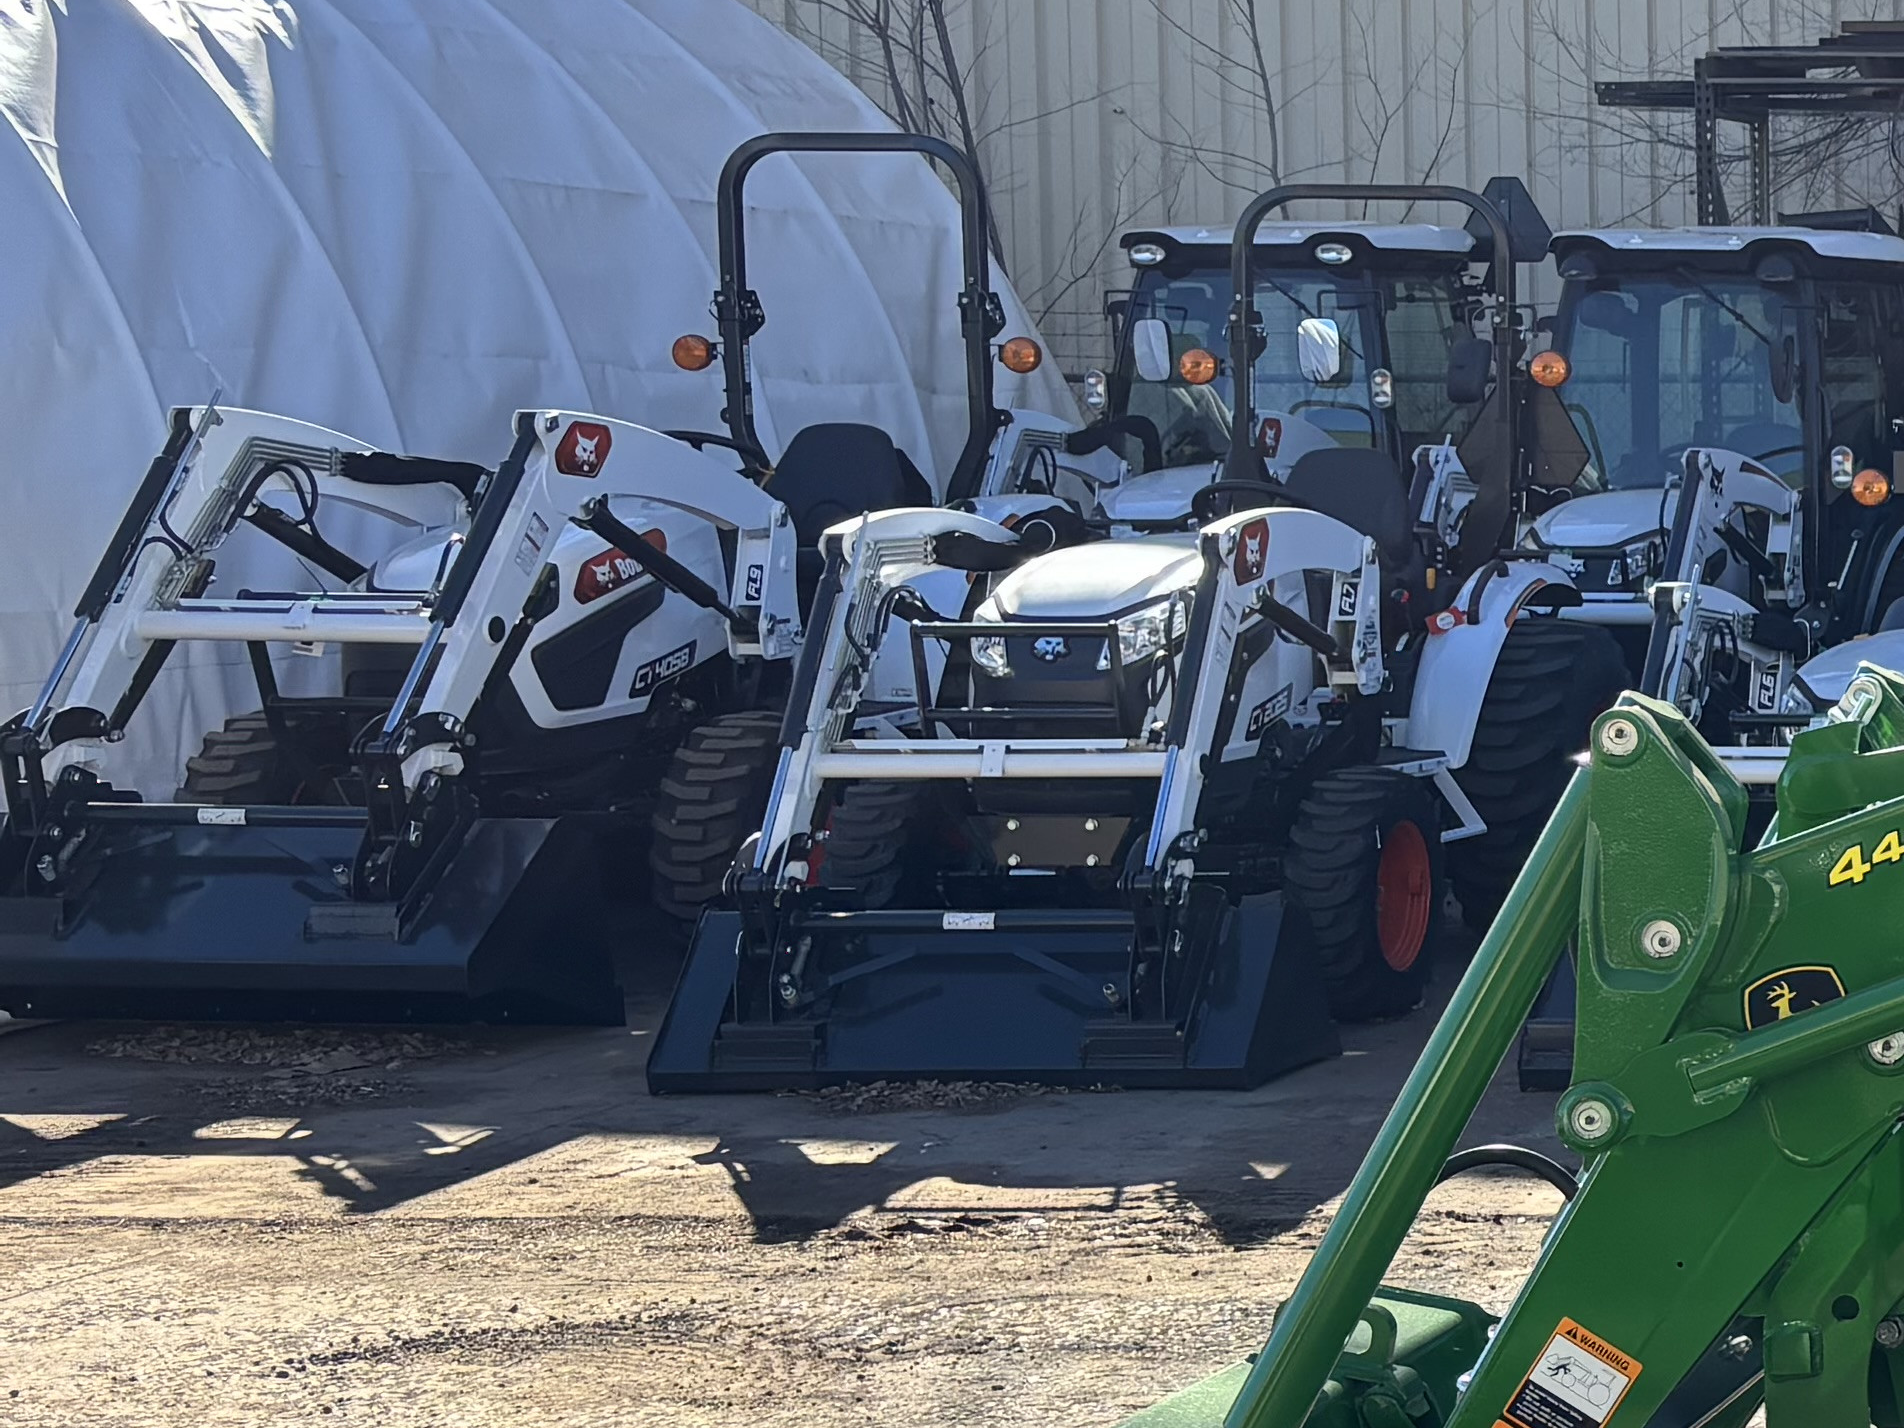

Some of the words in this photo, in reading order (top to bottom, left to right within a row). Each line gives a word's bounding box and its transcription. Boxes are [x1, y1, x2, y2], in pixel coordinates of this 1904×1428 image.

[747, 566, 762, 599] FL9
[1340, 585, 1356, 614] FL7
[1760, 673, 1775, 707] FL6
[1579, 1333, 1631, 1372] WARNING
